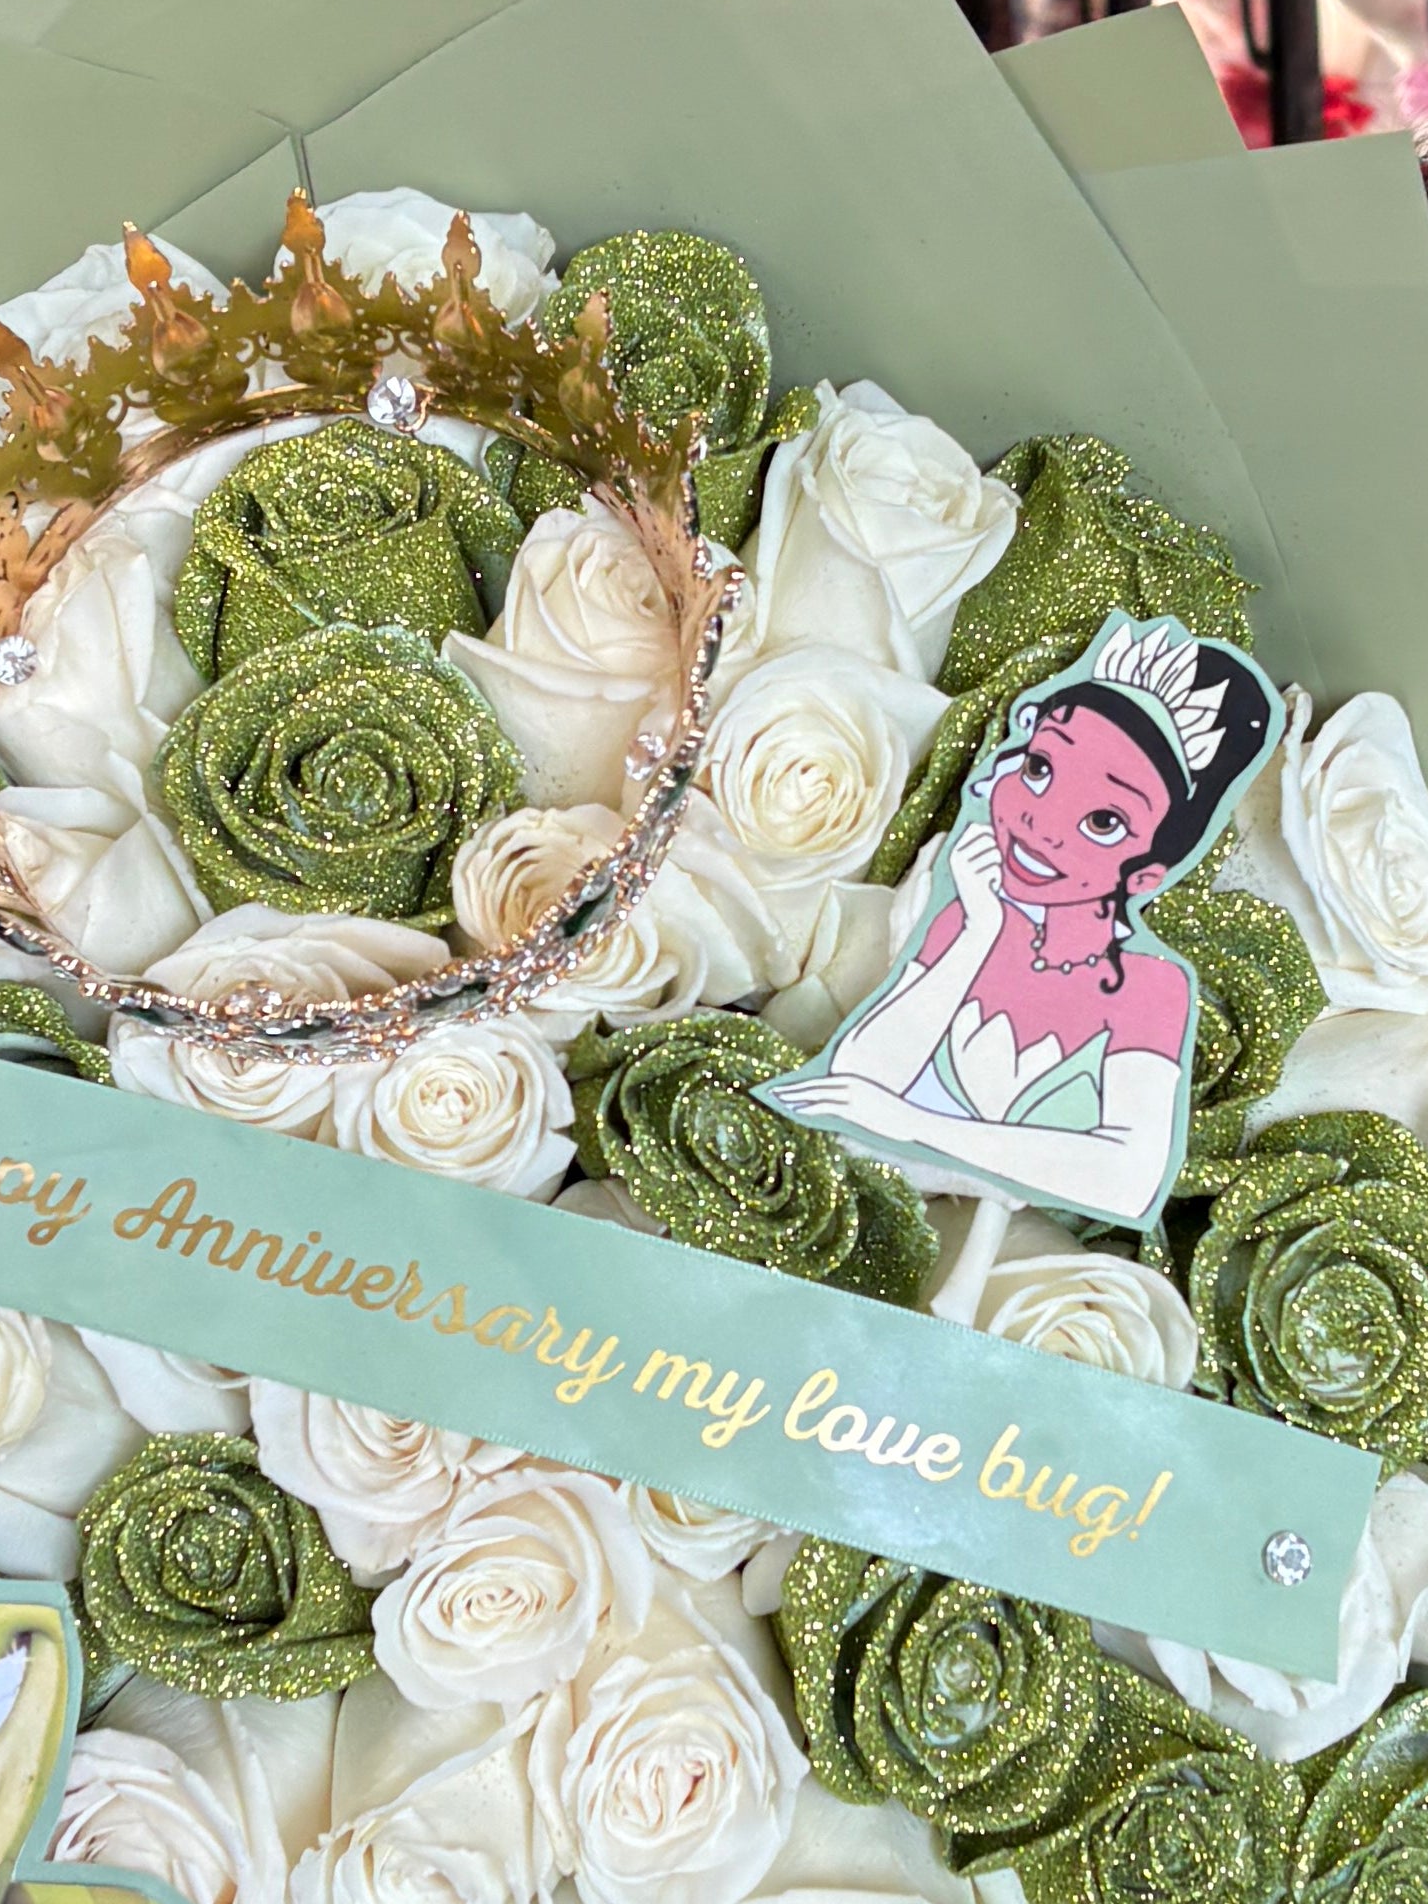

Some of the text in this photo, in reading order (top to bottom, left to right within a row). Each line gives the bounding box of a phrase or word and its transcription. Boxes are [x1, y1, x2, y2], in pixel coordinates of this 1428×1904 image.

[112, 1177, 625, 1406] Anniversary
[632, 1348, 771, 1448] my
[783, 1367, 963, 1482] love
[978, 1423, 1174, 1558] bug!
